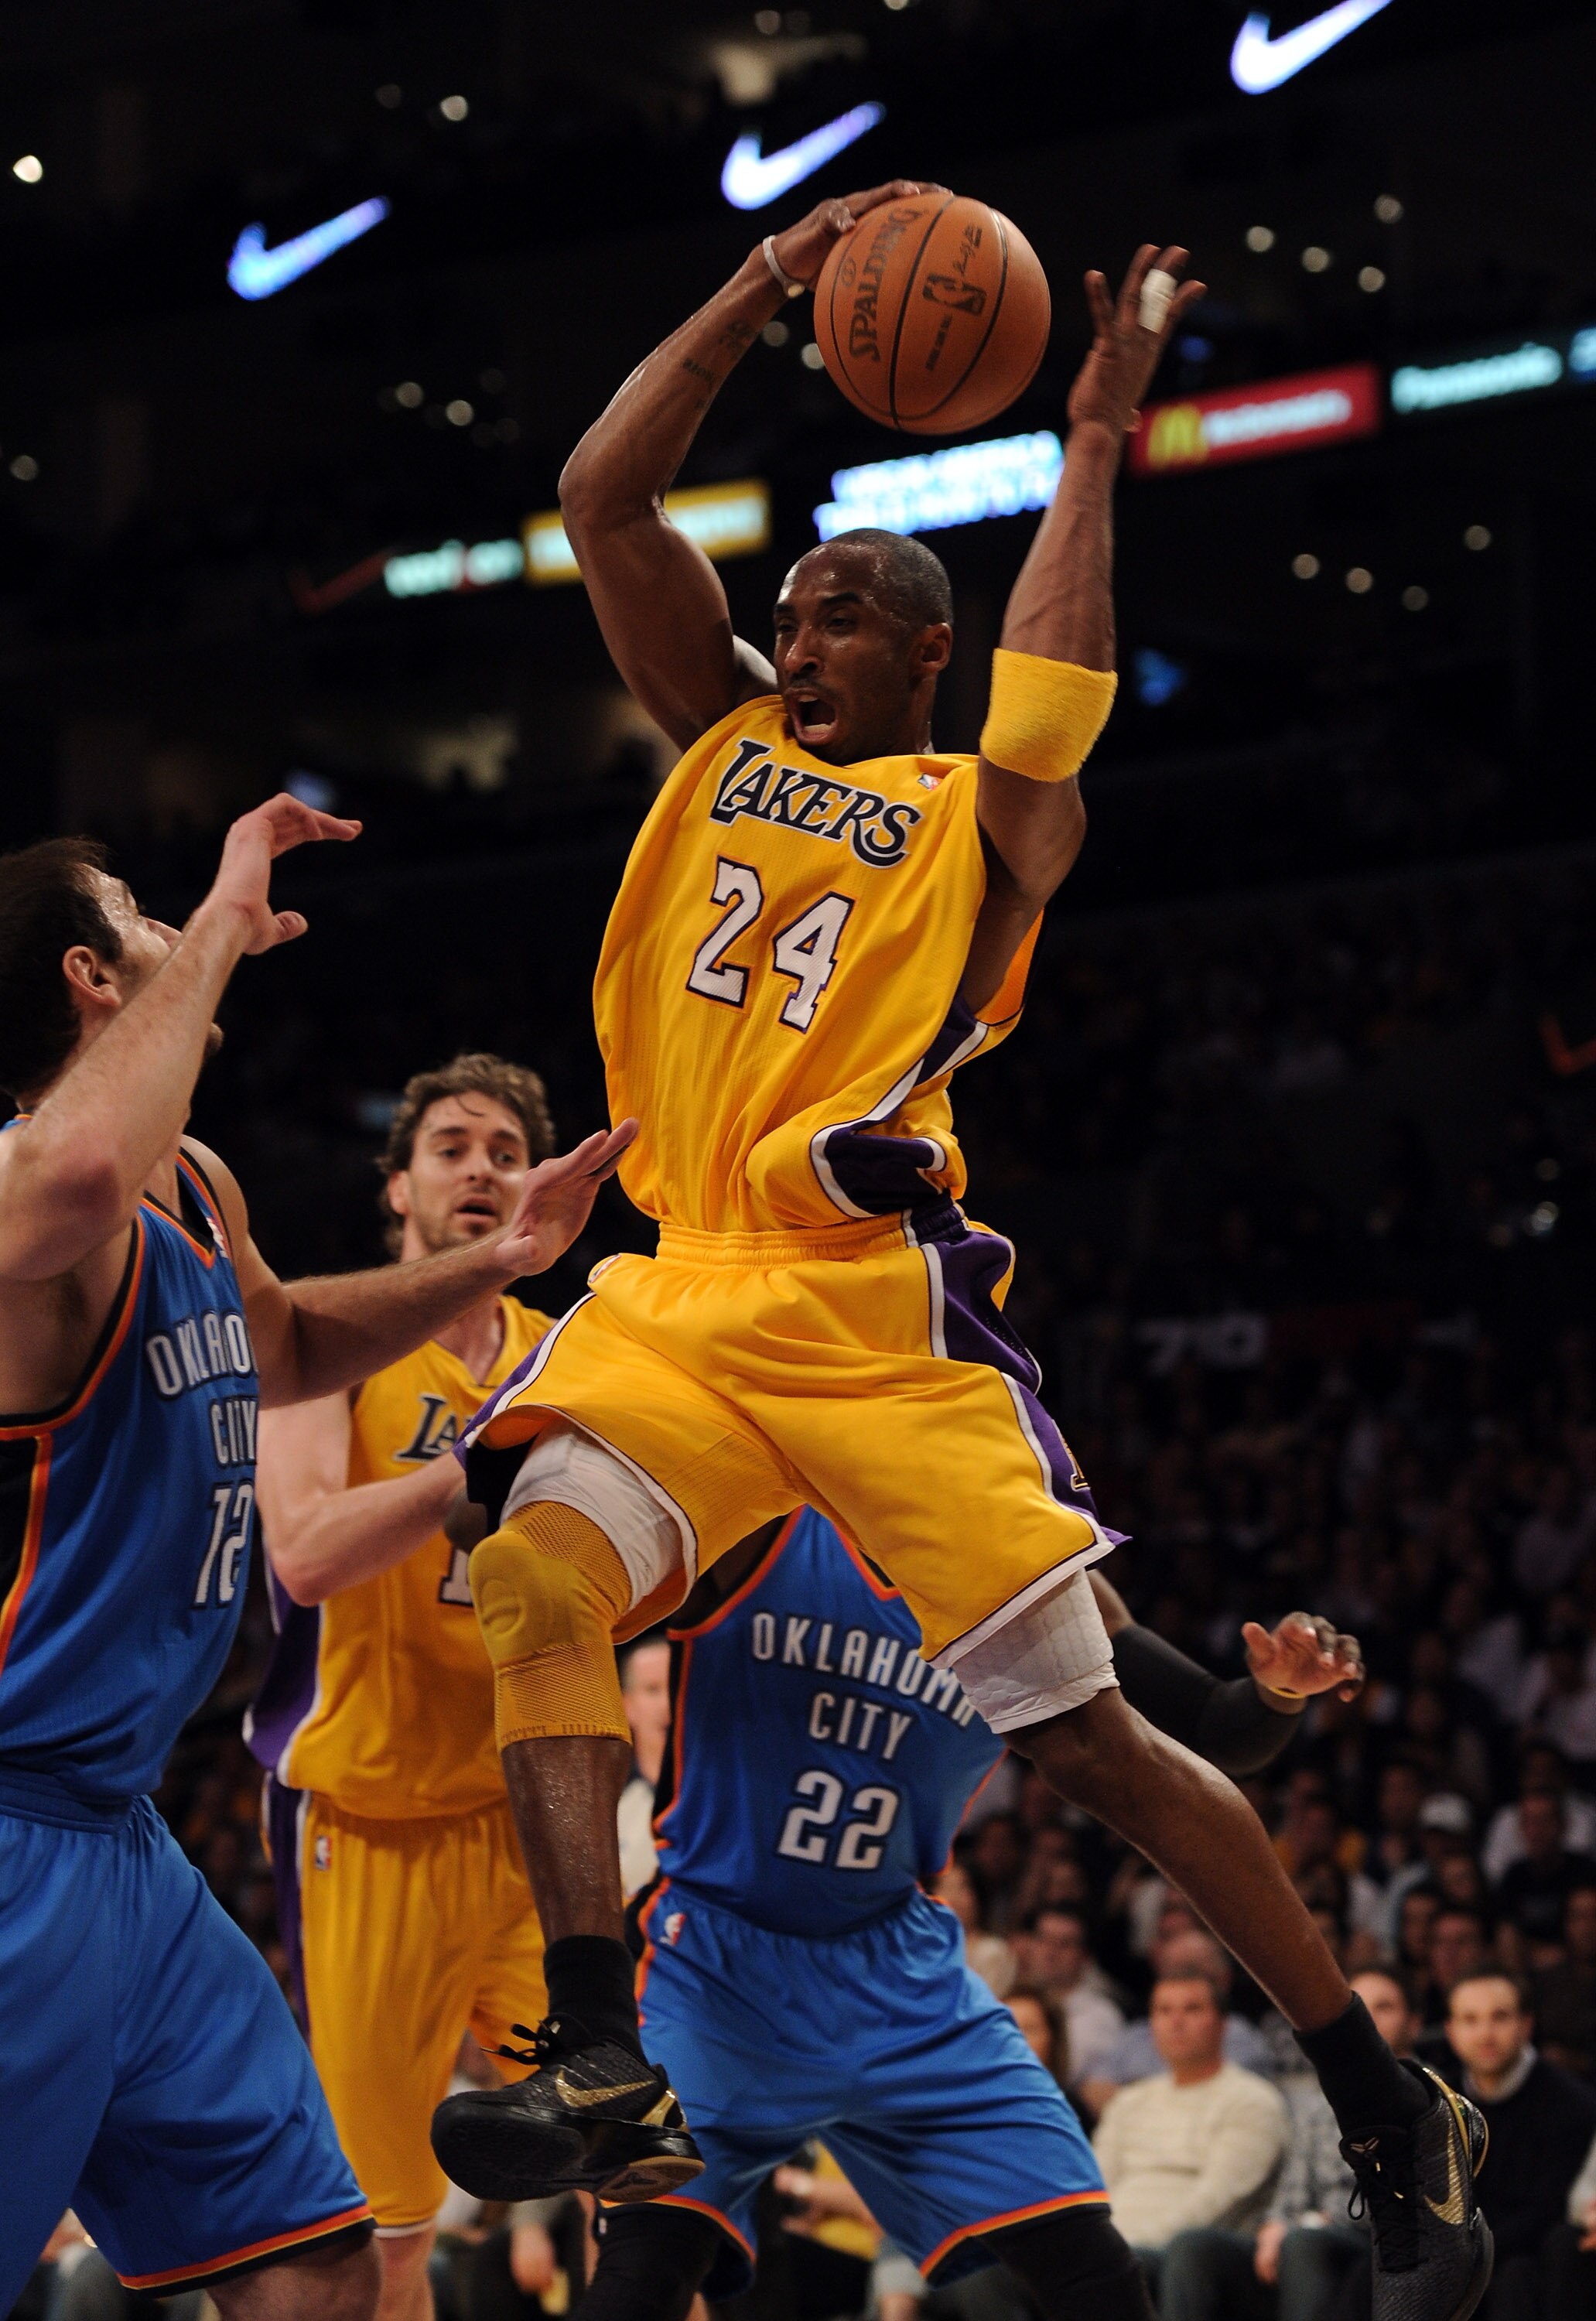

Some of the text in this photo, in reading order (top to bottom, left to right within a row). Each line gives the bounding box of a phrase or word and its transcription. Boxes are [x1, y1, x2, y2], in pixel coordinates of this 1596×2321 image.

[849, 207, 923, 363] SPALDING
[709, 737, 924, 869] LAKERS
[685, 855, 856, 1034] 24
[193, 1482, 255, 1607] 12
[808, 1692, 913, 1761] CITY
[777, 1769, 900, 1870] 22
